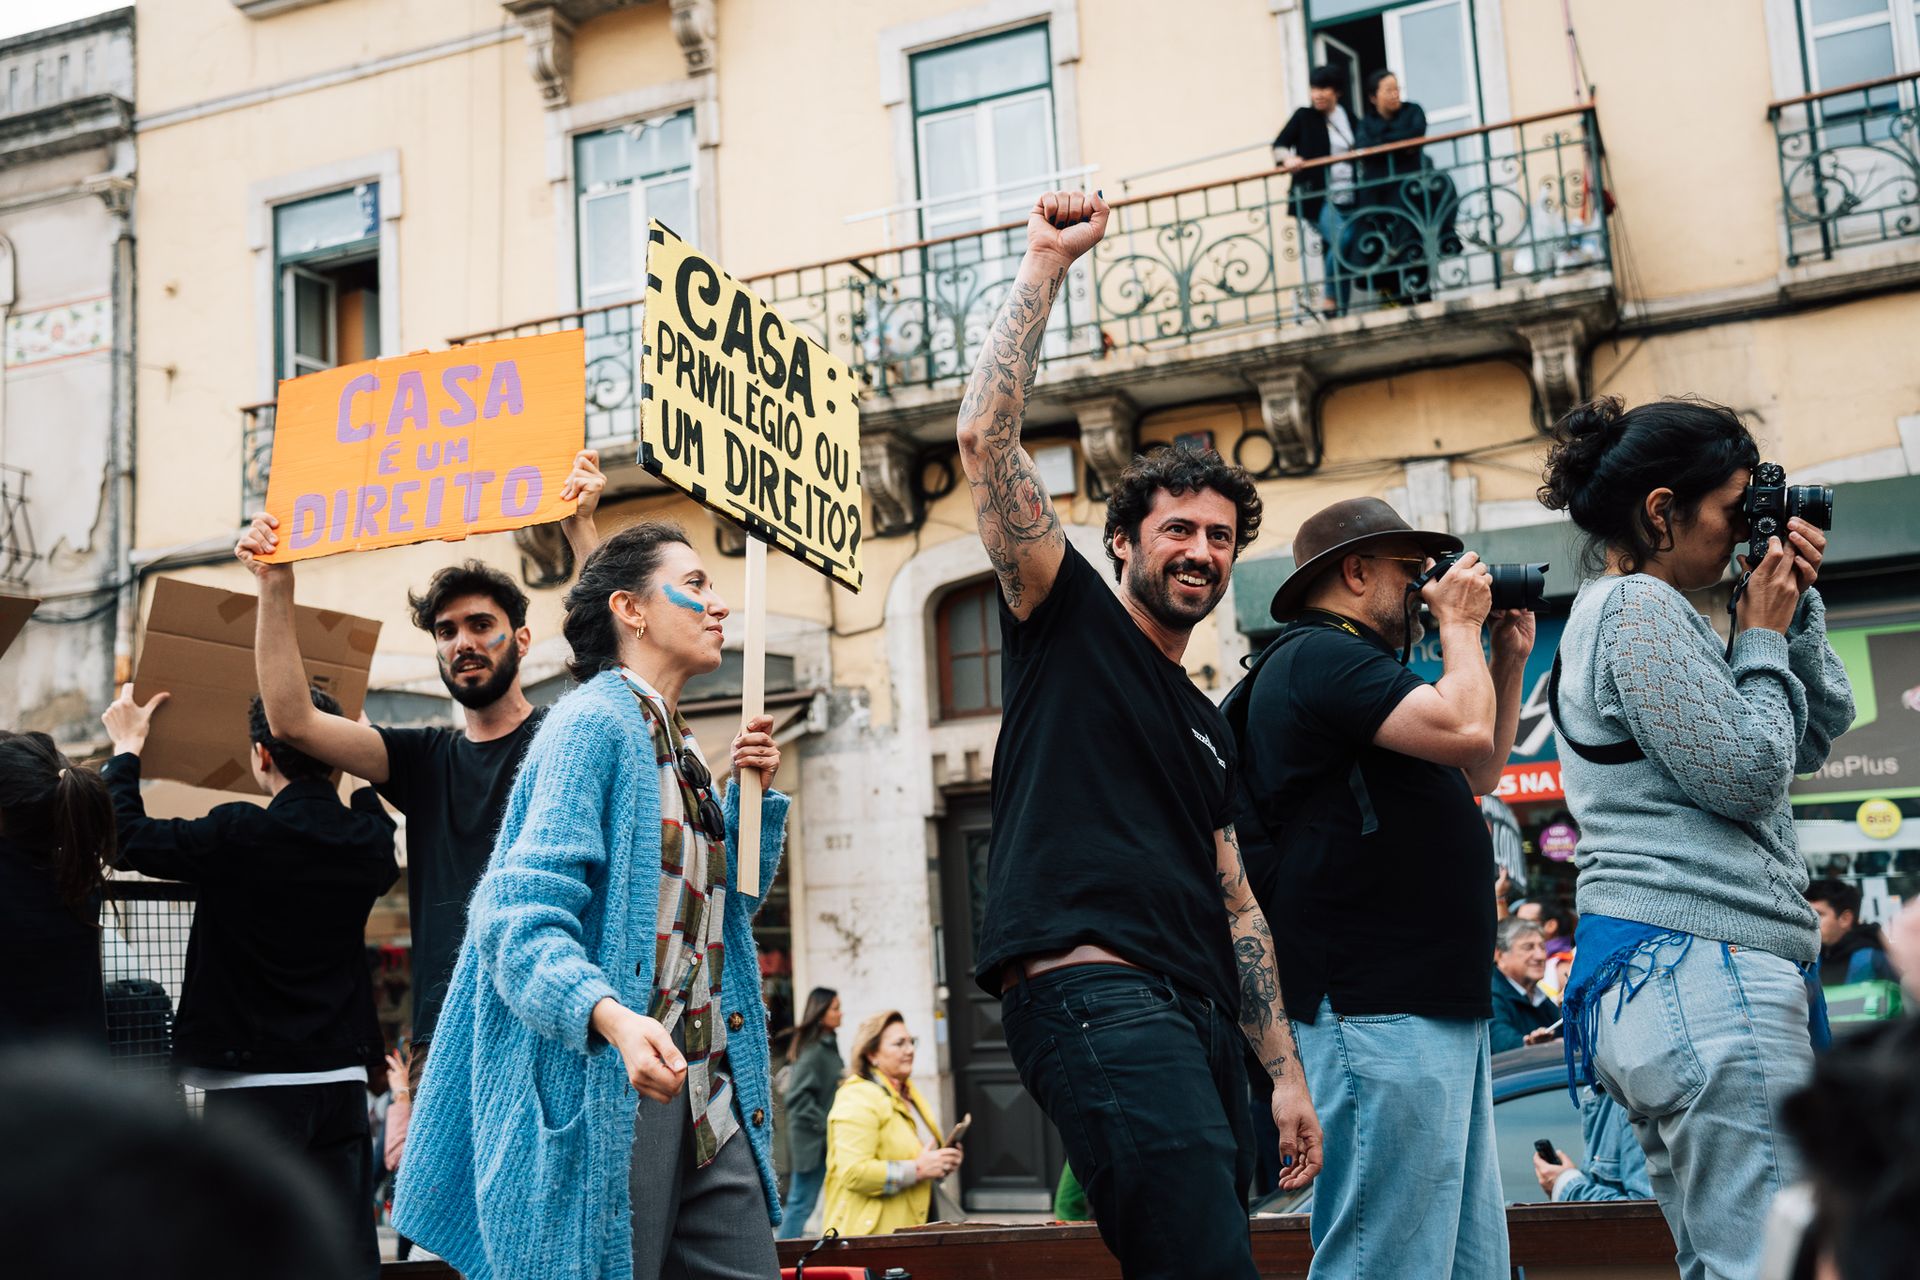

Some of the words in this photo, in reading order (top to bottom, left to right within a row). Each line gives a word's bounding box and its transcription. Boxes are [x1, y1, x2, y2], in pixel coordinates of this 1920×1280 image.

[336, 360, 525, 444] CASA
[656, 320, 803, 461] PRIVILÉGIO
[815, 431, 849, 493] OU
[378, 440, 401, 475] É
[416, 437, 469, 471] UM
[661, 398, 705, 476] UM
[723, 428, 863, 570] DIREITO?
[288, 465, 543, 550] DIREITO
[1519, 770, 1557, 794] NA
[1796, 754, 1900, 781] nePlus
